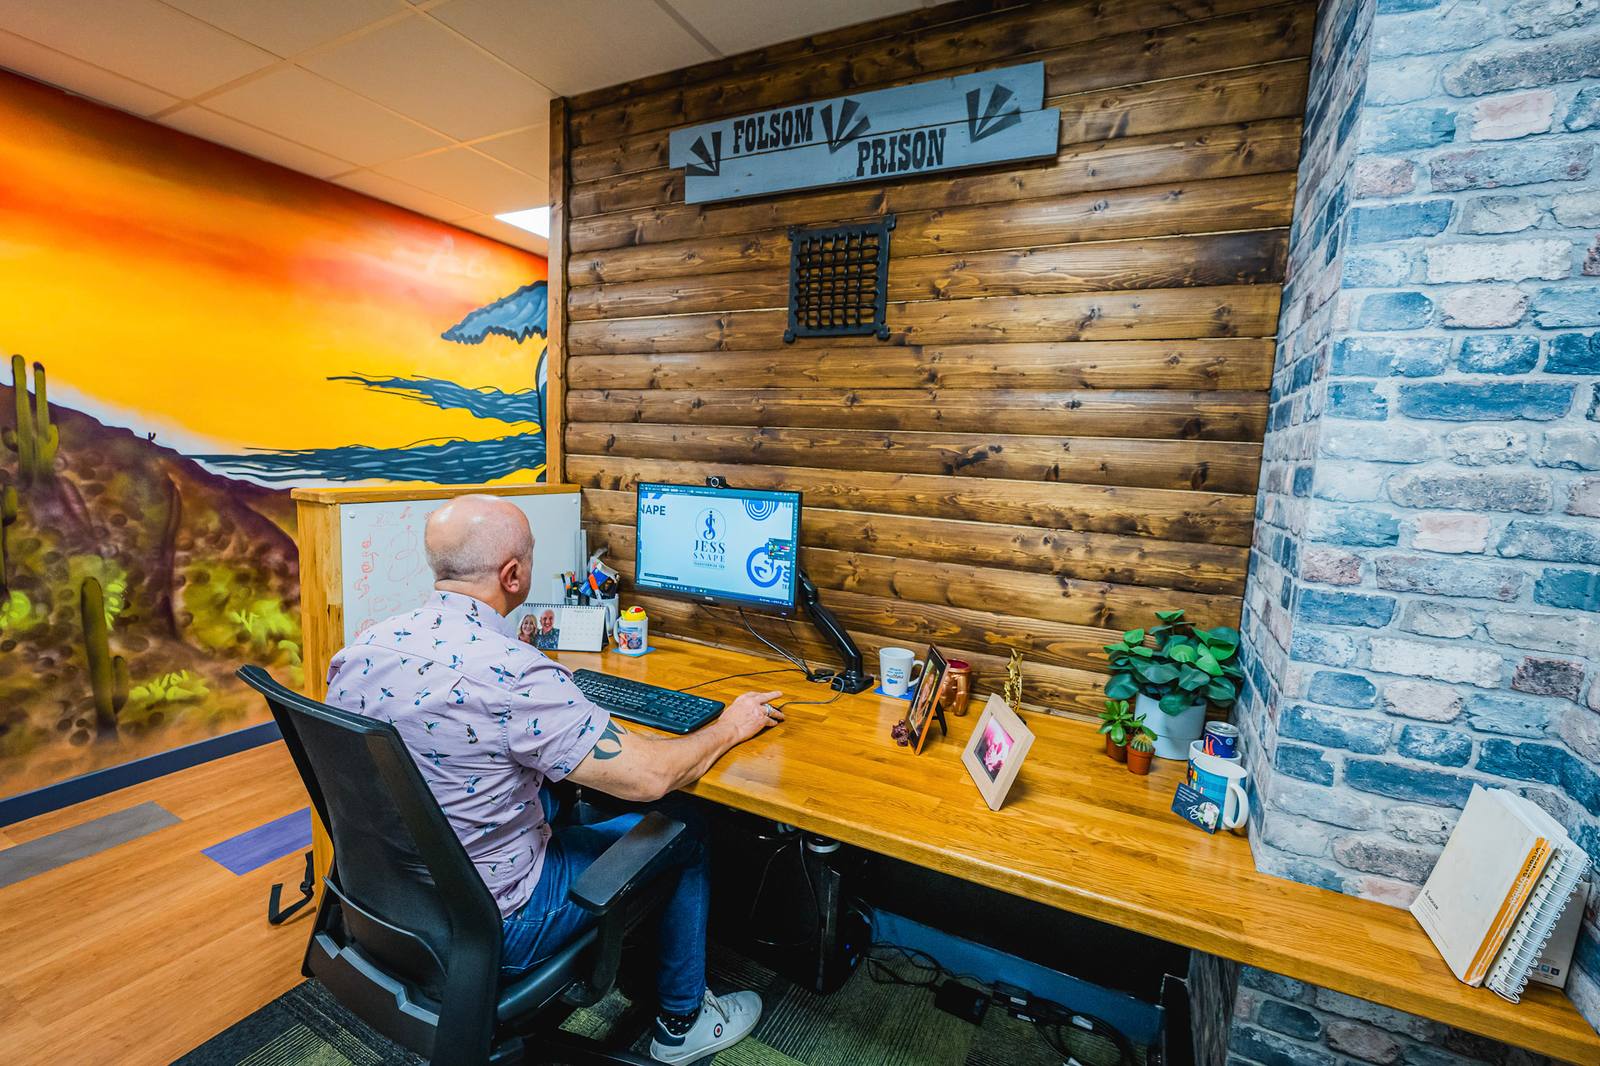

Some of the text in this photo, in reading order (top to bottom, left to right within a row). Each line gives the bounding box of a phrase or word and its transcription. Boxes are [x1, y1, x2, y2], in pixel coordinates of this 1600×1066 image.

[733, 107, 814, 154] FOLSOM
[856, 128, 946, 177] PRISON
[693, 552, 726, 563] SNAPE
[694, 540, 726, 555] JESS
